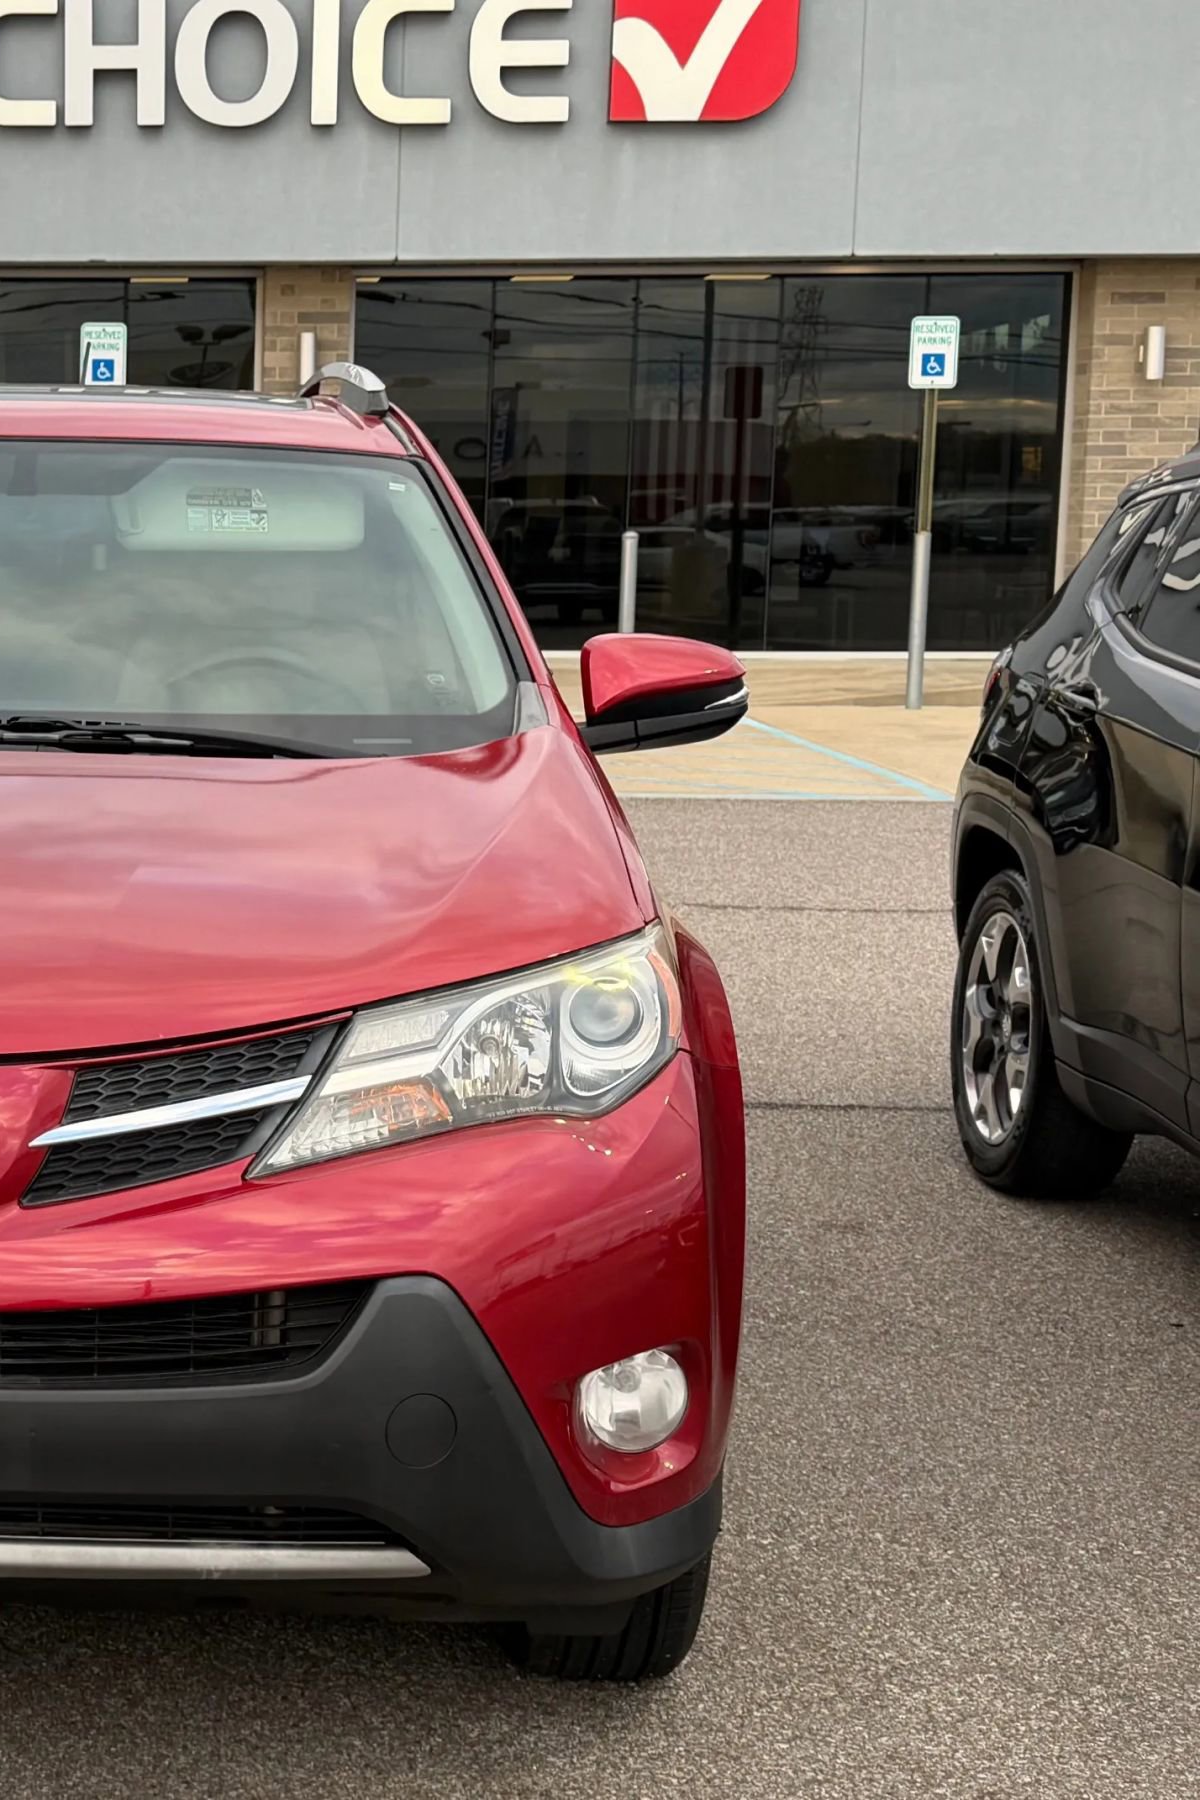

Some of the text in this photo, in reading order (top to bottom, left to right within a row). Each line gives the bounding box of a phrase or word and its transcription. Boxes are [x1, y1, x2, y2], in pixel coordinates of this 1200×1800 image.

[914, 324, 956, 334] RESERVED
[917, 336, 952, 345] PARKING
[89, 342, 120, 352] ARKING
